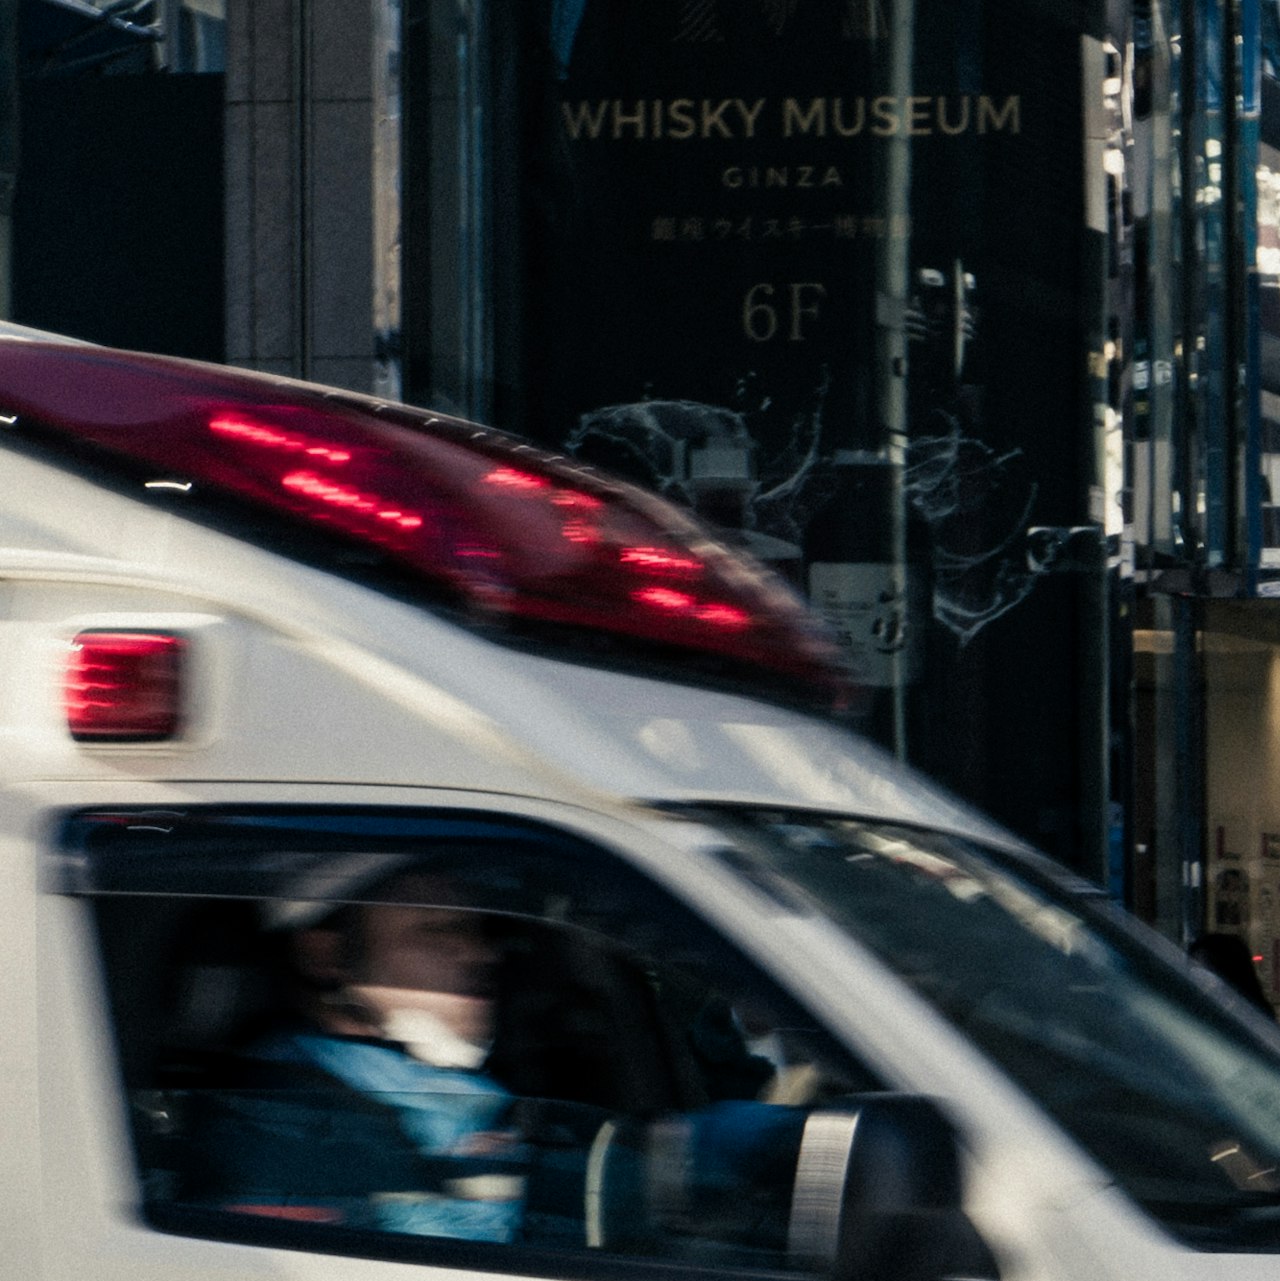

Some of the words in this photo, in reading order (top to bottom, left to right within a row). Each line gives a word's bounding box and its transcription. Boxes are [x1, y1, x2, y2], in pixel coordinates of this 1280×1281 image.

[562, 97, 767, 139] WHISKY
[783, 94, 1021, 137] MUSEUM
[722, 166, 844, 188] GINZA
[743, 282, 828, 343] 6F
